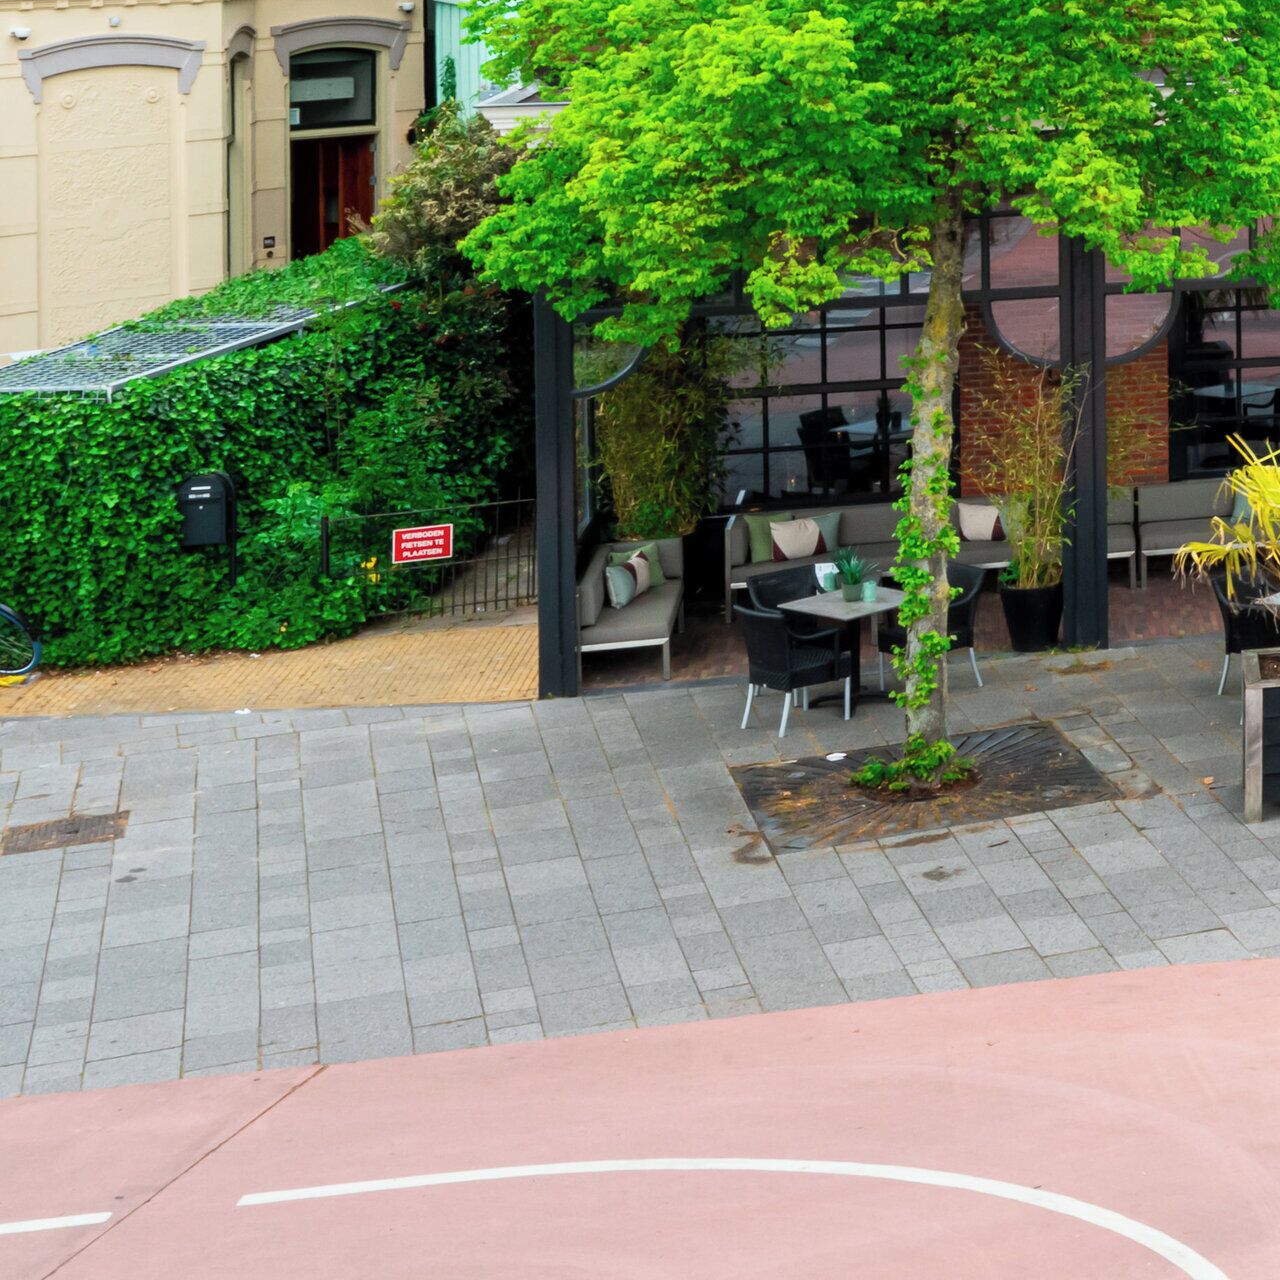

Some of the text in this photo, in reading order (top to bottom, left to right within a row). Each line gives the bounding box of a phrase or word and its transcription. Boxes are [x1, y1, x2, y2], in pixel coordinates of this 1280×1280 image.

[402, 530, 444, 539] VERBODEN
[401, 540, 433, 549] FIETSEN
[403, 548, 442, 557] PLAATSEN
